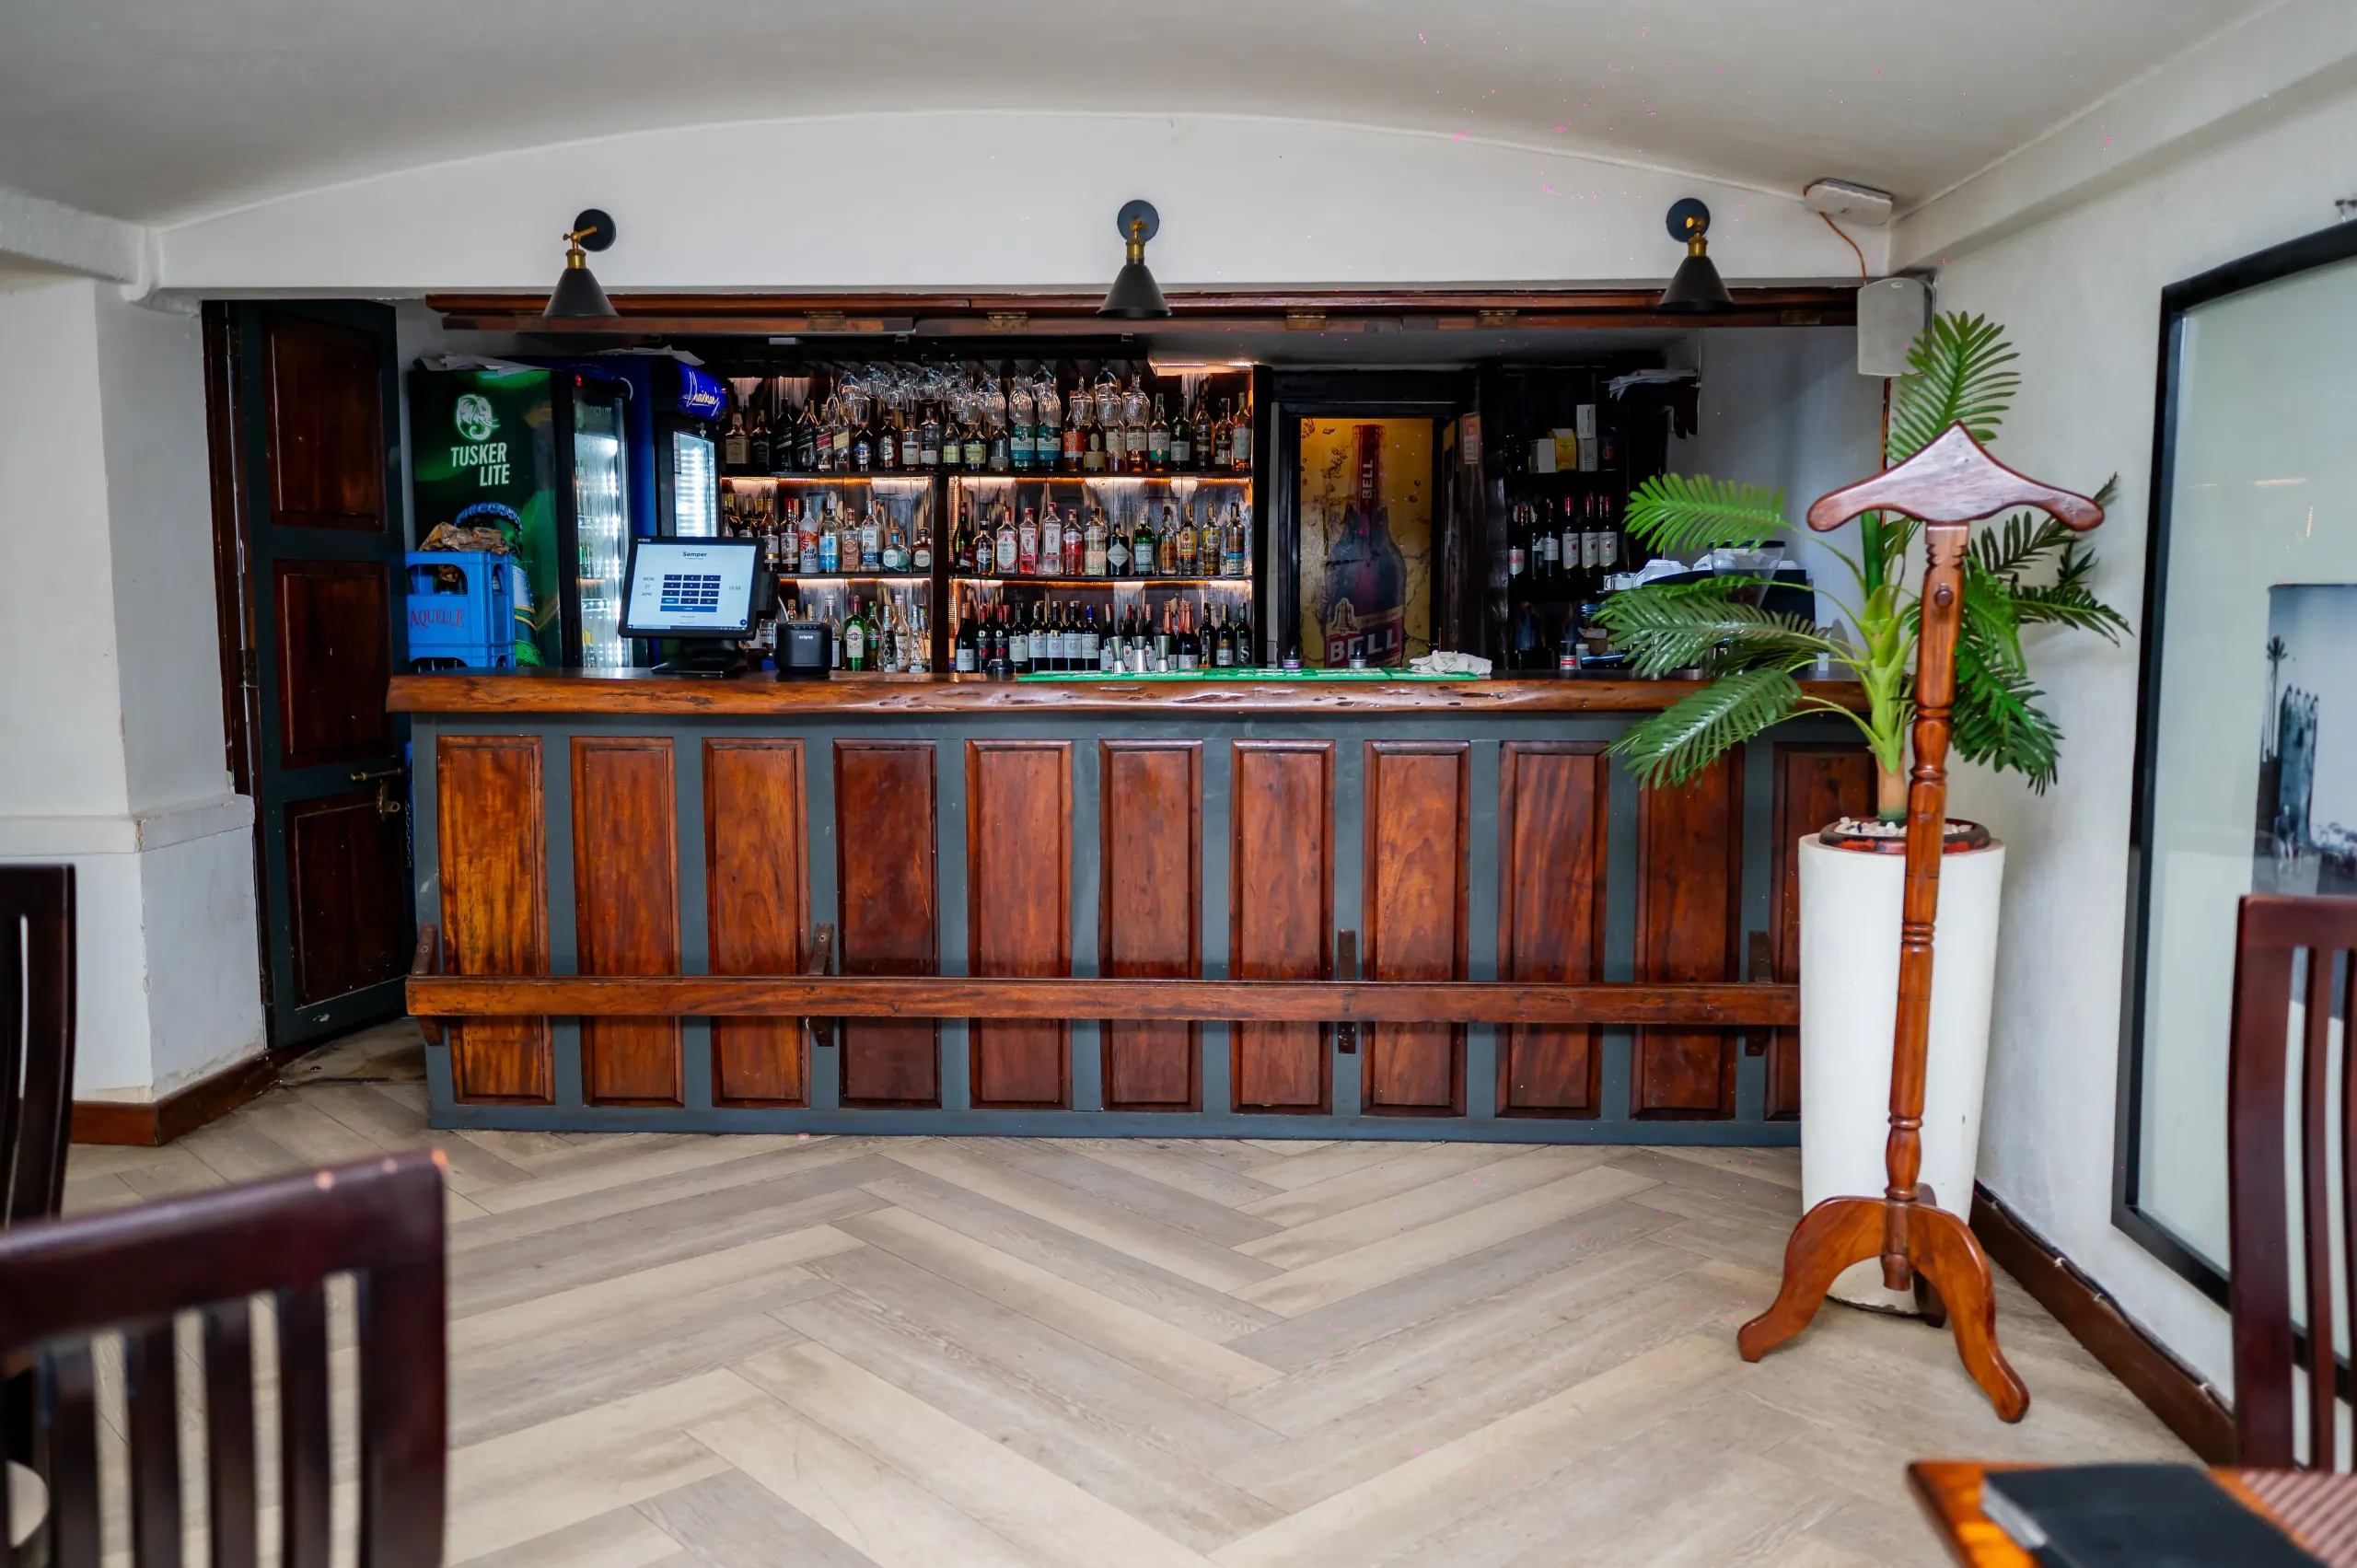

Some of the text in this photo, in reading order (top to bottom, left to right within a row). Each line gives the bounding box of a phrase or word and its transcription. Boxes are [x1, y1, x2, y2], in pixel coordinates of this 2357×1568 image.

[450, 442, 507, 467] TUSKER
[480, 463, 510, 486] LITE
[1363, 459, 1373, 499] BELL
[410, 608, 465, 630] AQUELLE
